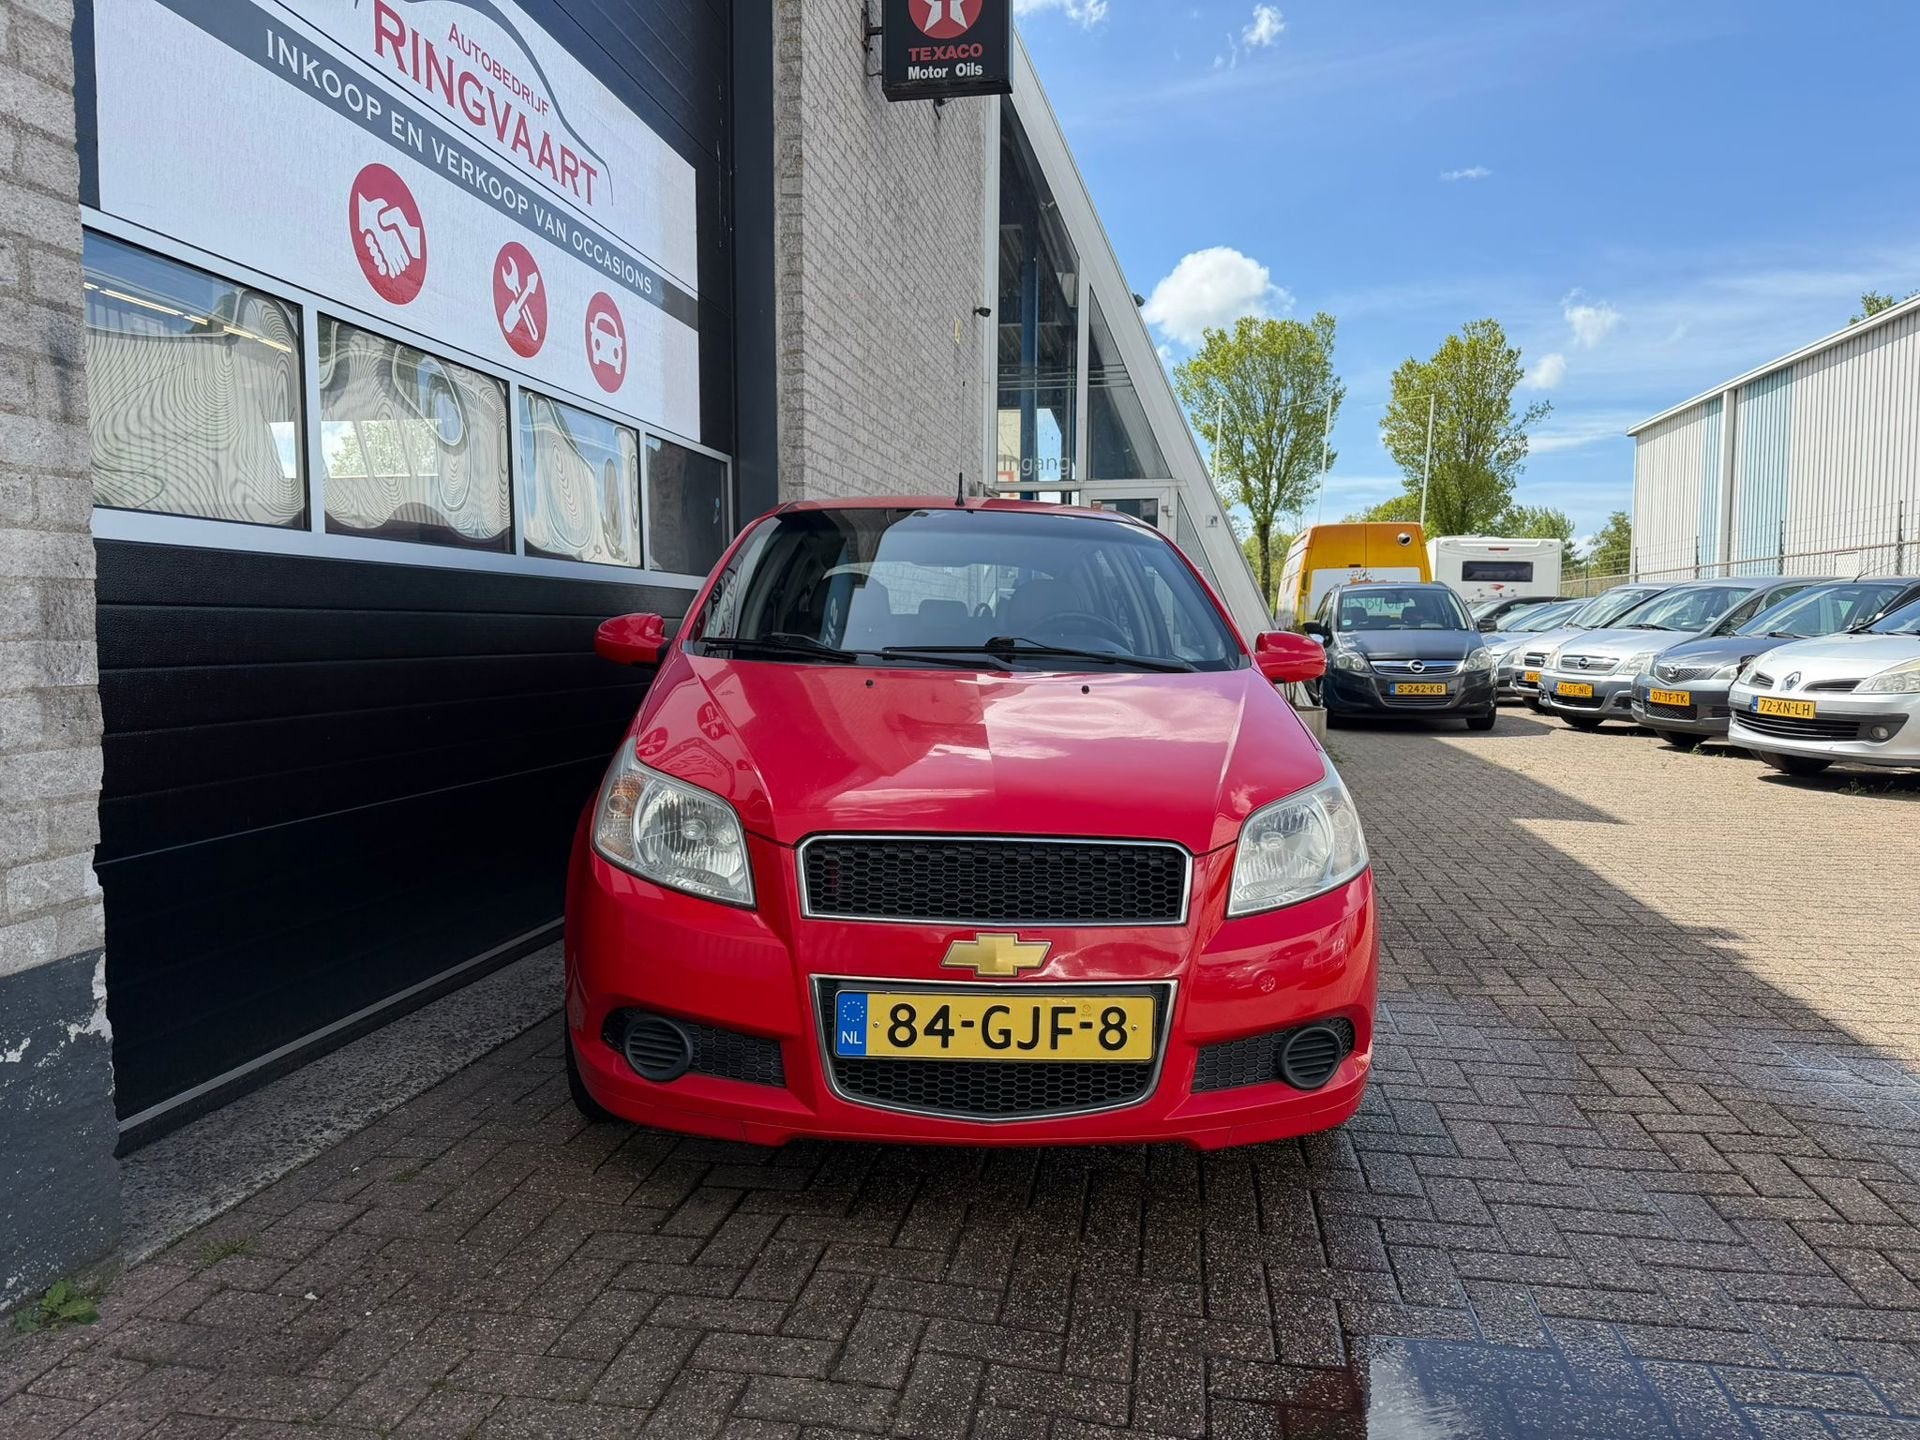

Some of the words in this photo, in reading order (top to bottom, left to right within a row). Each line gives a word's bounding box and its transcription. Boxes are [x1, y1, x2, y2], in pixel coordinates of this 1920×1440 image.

[908, 43, 983, 62] TEXACO
[449, 22, 549, 117] AUTOBEDRIJF
[908, 65, 949, 80] Motor
[955, 62, 983, 77] Oils
[374, 0, 597, 207] RINGVAART
[266, 28, 382, 121] INKOOP
[391, 110, 423, 153] EN
[431, 136, 529, 216] VERKOOP
[533, 203, 567, 242] VAN
[572, 230, 652, 294] OCCASIONS
[1398, 684, 1443, 694] S-242-KB
[1761, 699, 1810, 716] 72-XN-LH
[842, 1031, 863, 1045] NL
[887, 1003, 1128, 1051] 84-GJF-8
